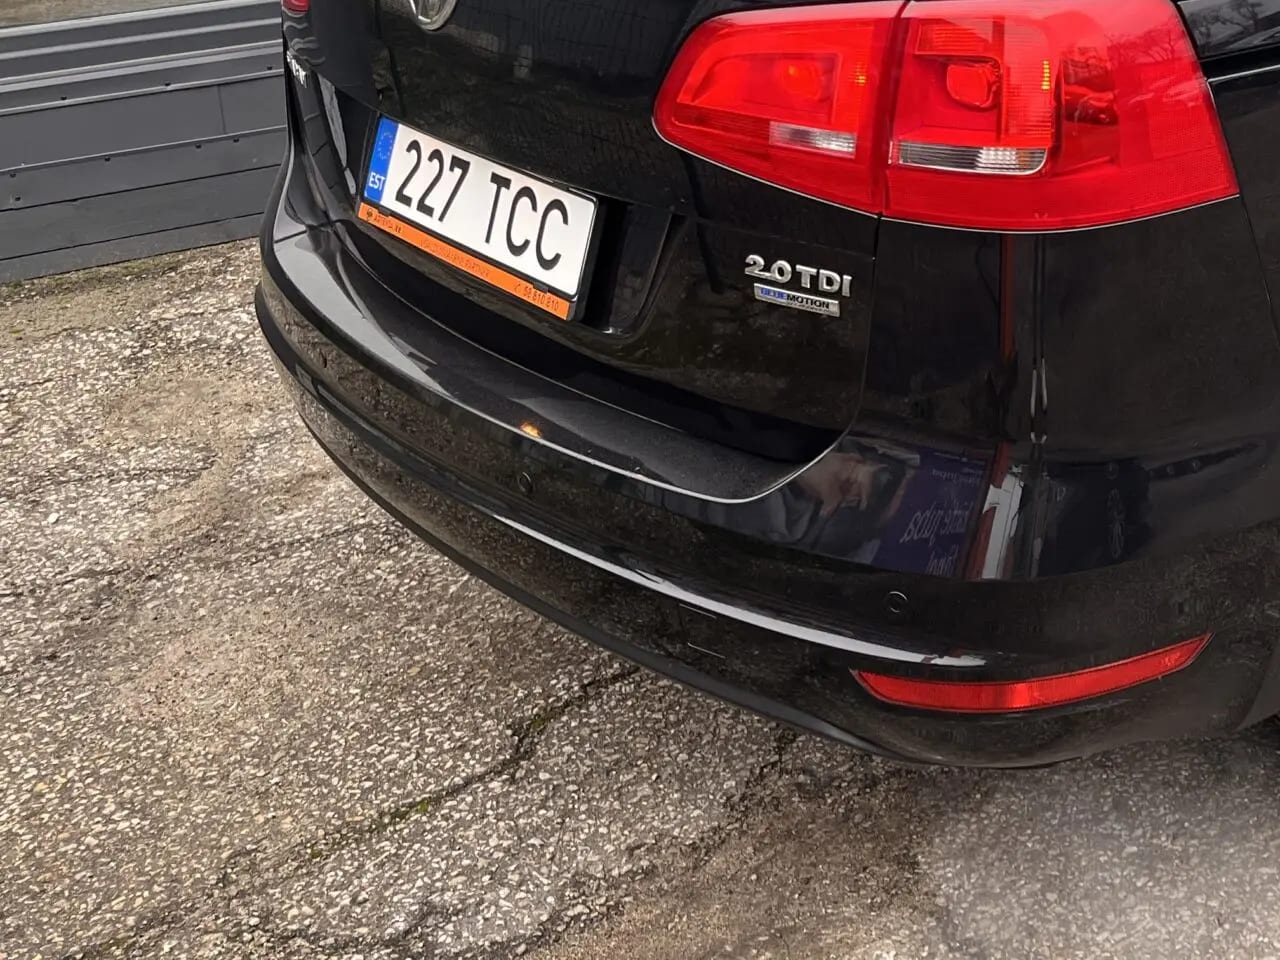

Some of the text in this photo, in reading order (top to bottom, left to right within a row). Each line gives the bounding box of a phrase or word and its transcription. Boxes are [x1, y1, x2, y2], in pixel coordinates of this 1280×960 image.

[369, 171, 386, 188] EST
[395, 139, 471, 222] 227
[485, 171, 569, 271] TCC
[795, 264, 852, 297] TDI
